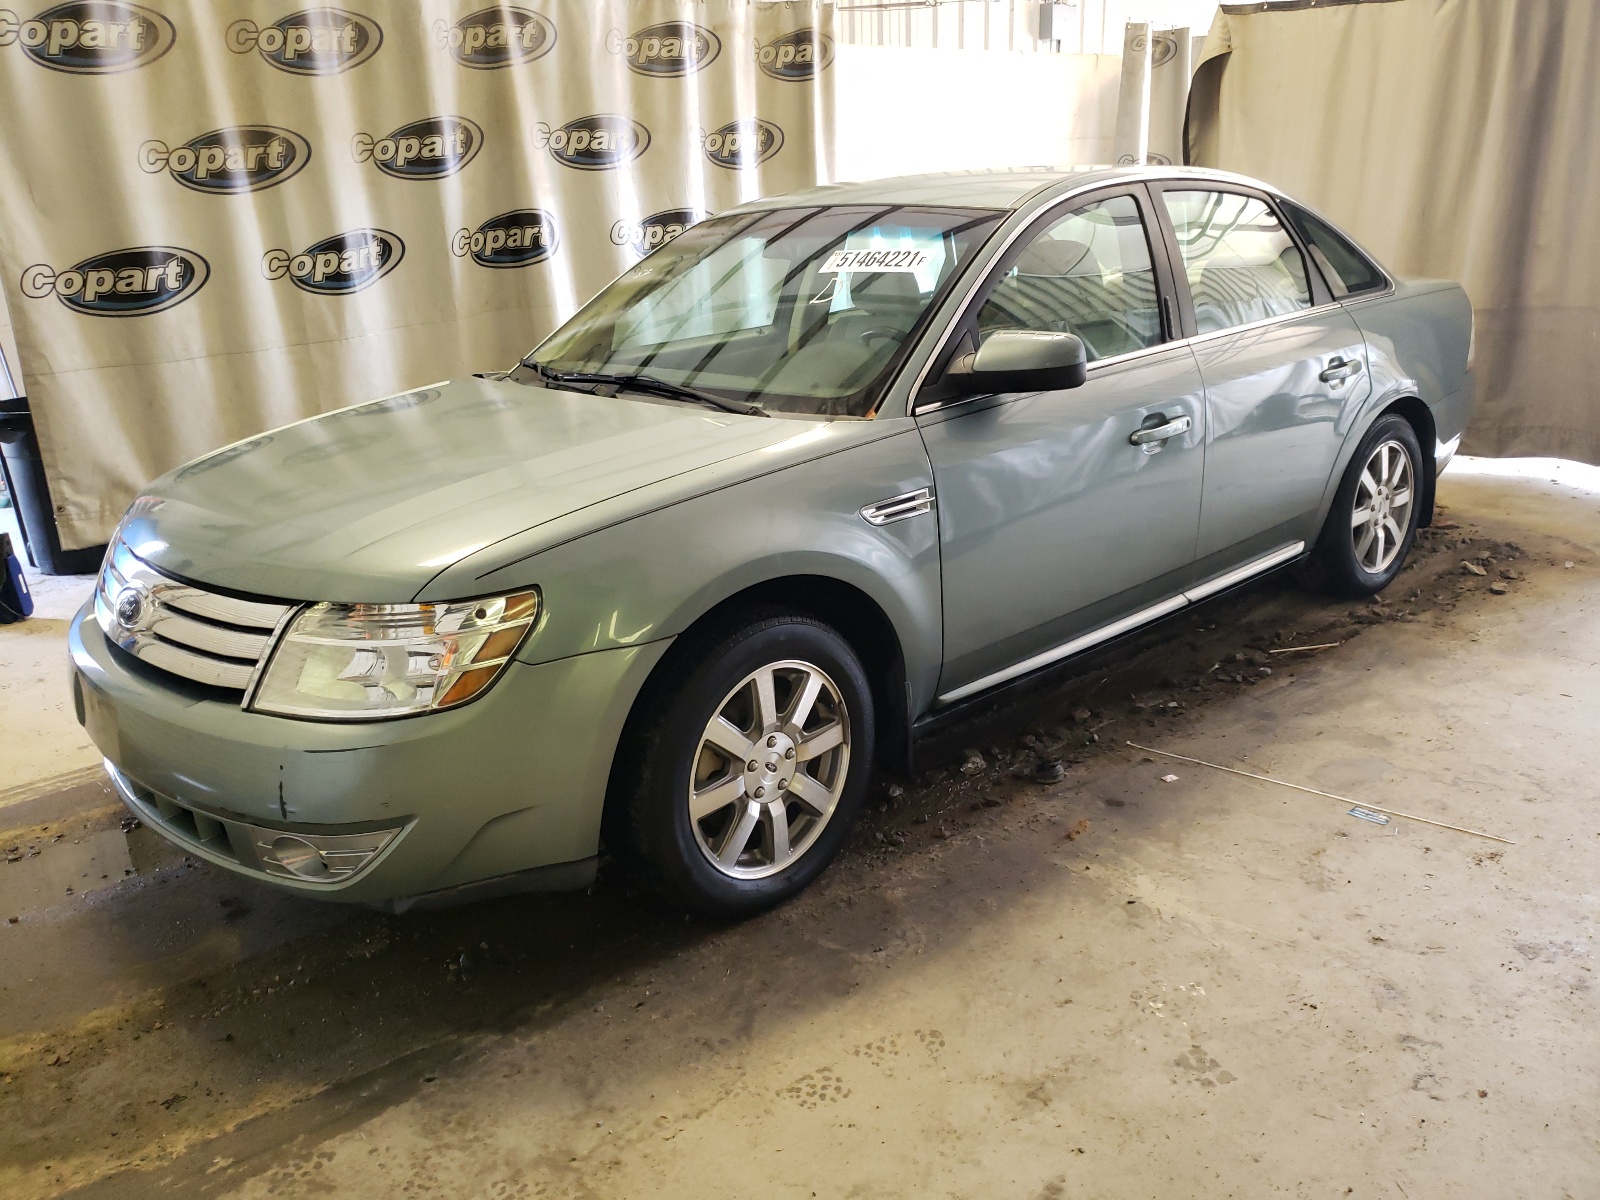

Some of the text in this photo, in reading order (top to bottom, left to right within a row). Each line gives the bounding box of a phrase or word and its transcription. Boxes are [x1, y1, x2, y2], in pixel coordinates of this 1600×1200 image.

[0, 9, 146, 57] Copart
[225, 19, 359, 60] Copart
[432, 19, 538, 57] Copart
[605, 28, 702, 64] Copart
[138, 136, 285, 179] Copart
[351, 125, 466, 168] Copart
[531, 122, 623, 157] Copar
[452, 217, 550, 257] Copart
[610, 219, 694, 250] Copa
[20, 256, 184, 302] Copart
[261, 236, 383, 283] Copart
